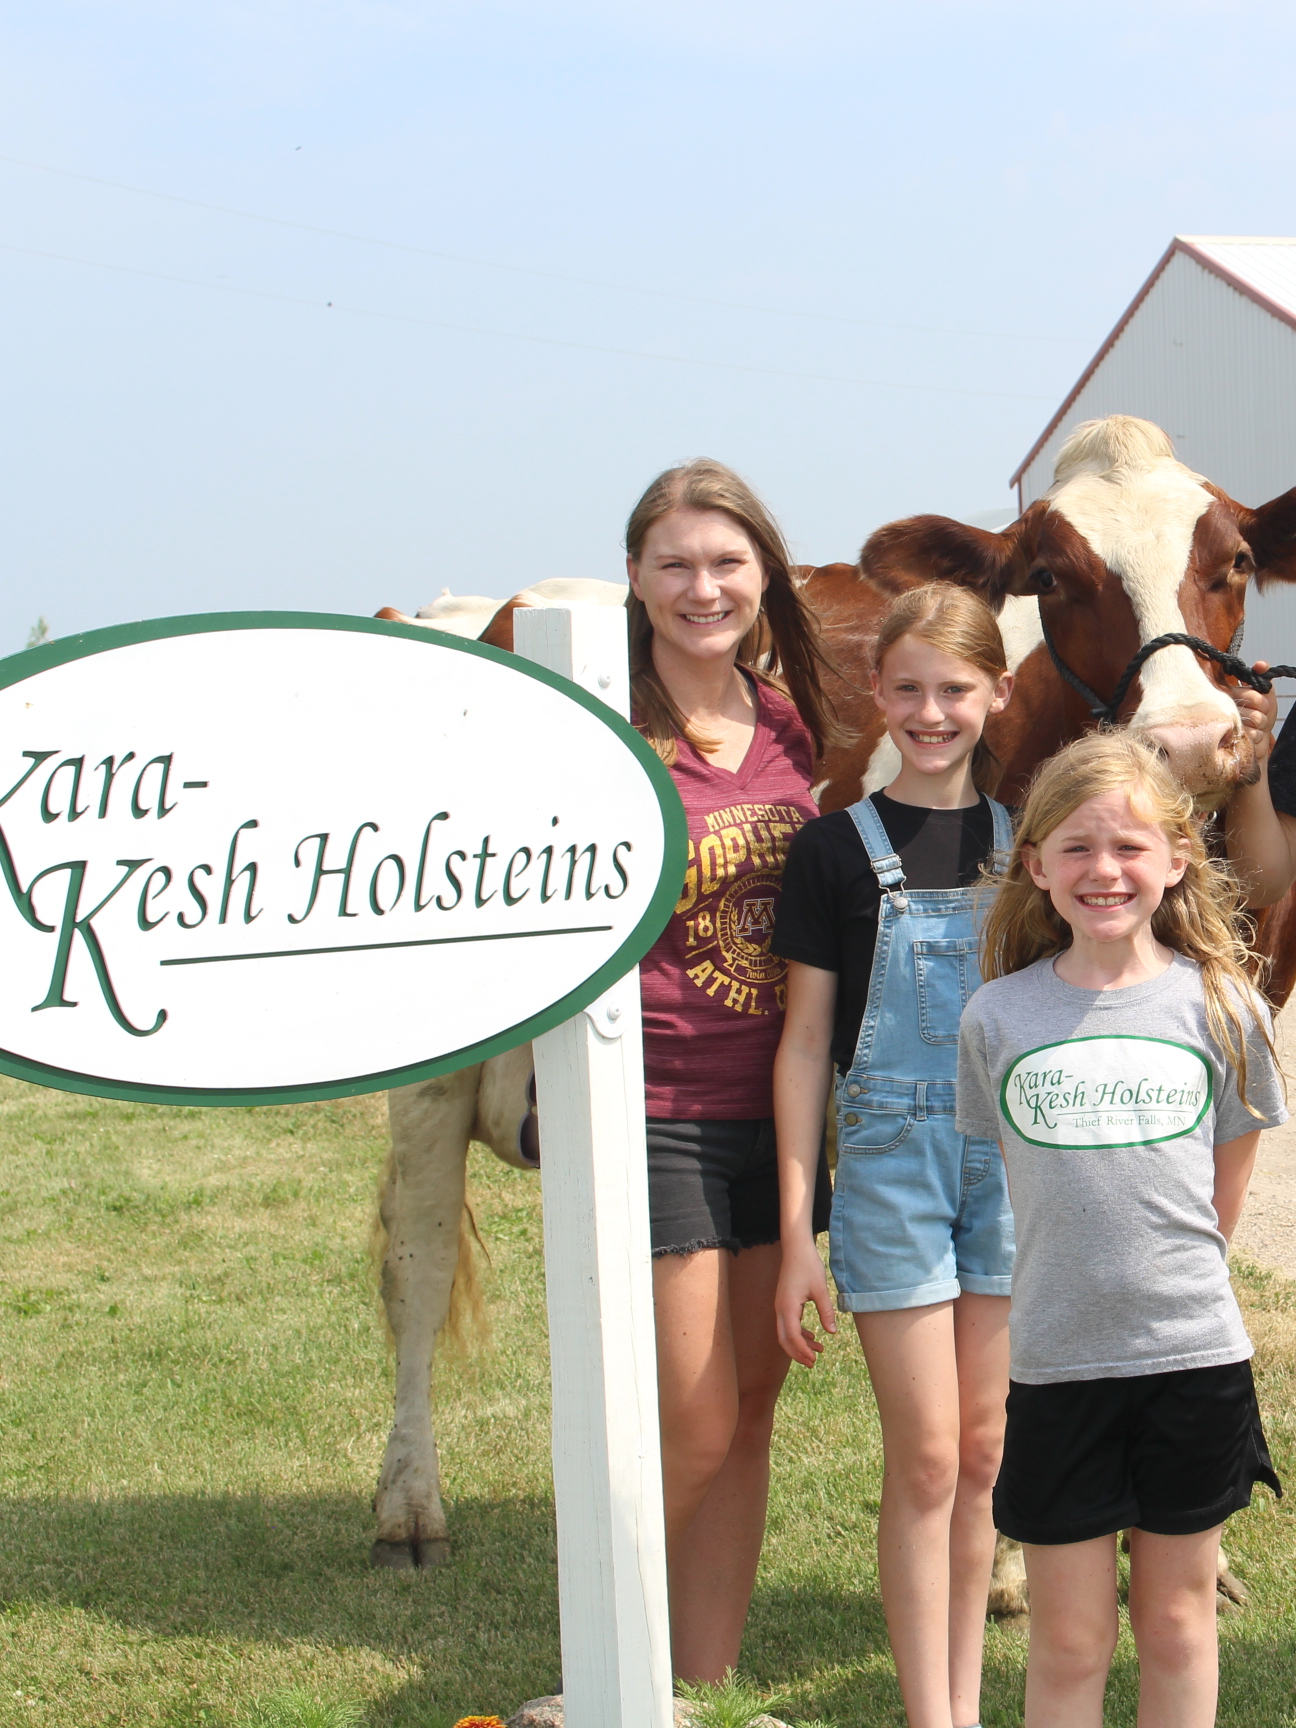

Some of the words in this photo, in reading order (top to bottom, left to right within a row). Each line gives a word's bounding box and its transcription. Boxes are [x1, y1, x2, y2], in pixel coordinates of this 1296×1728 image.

[704, 803, 805, 833] MINNESOTA
[674, 822, 803, 914] GOPHE
[28, 818, 264, 1037] Kesh
[287, 811, 633, 925] Holsteins
[685, 910, 714, 947] 18
[736, 898, 775, 937] M
[686, 959, 769, 1016] ATHL.
[1013, 1068, 1074, 1109] Kara-
[1028, 1080, 1087, 1130] Kesh
[1092, 1078, 1201, 1108] Holsteins
[1072, 1115, 1102, 1129] Thief
[1106, 1116, 1134, 1126] River
[1138, 1114, 1164, 1128] Falls,
[1167, 1115, 1186, 1127] MN
